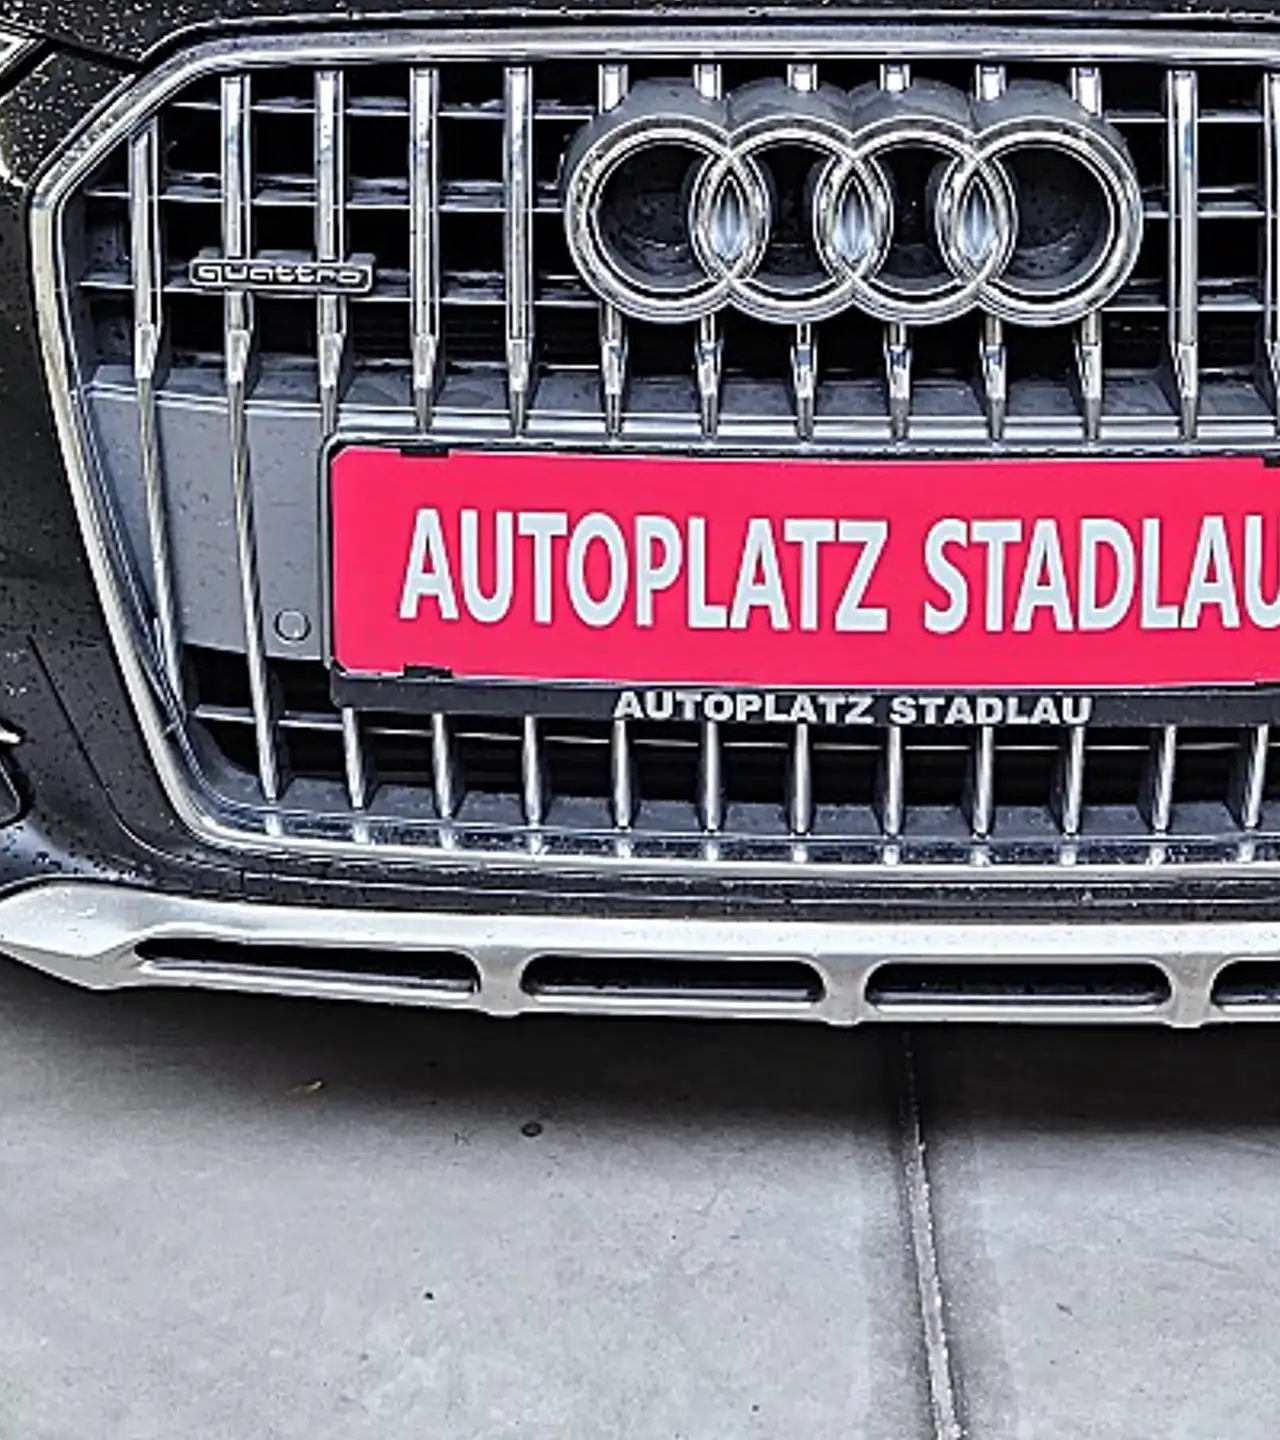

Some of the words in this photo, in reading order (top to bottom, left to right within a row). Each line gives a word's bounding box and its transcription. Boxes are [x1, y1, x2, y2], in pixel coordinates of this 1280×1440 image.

[198, 265, 362, 284] quattro
[399, 508, 890, 633] AUTOPLATZ
[613, 690, 874, 725] AUTOPLATZ
[889, 696, 1092, 726] STADLAU
